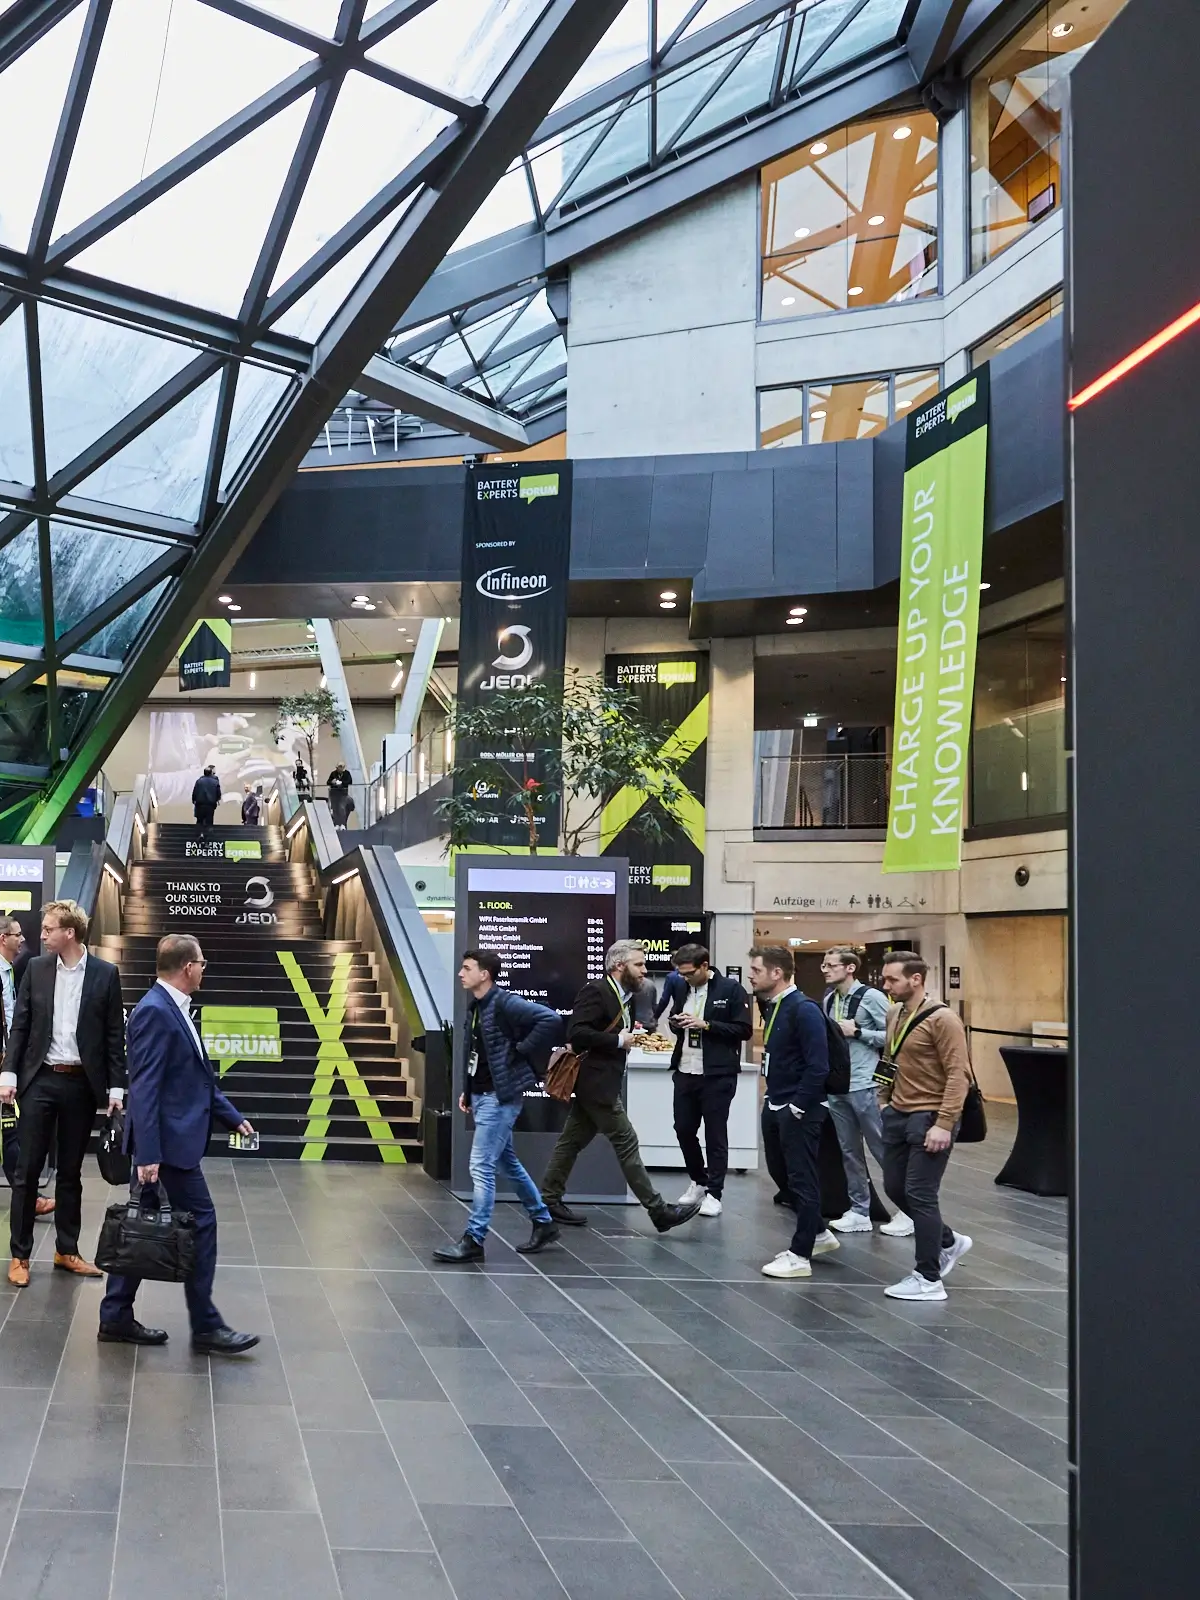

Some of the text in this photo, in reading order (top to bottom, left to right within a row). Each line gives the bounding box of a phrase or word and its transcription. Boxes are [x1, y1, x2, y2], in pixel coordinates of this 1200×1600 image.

[916, 399, 946, 427] BATTERY
[916, 411, 946, 438] EXPERTS
[477, 479, 518, 490] BATTERY
[477, 489, 518, 500] EXPERTS
[521, 486, 557, 496] FORUM
[892, 480, 936, 840] CHARGE UP YOUR
[617, 664, 657, 674] BATTERY
[616, 674, 656, 684] EXPERTS
[930, 560, 968, 835] KNOWLEDGE
[186, 848, 224, 857] EXPERTS
[654, 876, 689, 884] FORUM
[166, 882, 220, 892] THANKS TO
[165, 894, 222, 904] OUR SILVER
[773, 896, 816, 908] Aufzüge
[168, 906, 217, 916] SPONSOR
[235, 912, 285, 924] JEOL
[202, 1034, 279, 1055] FORUM
